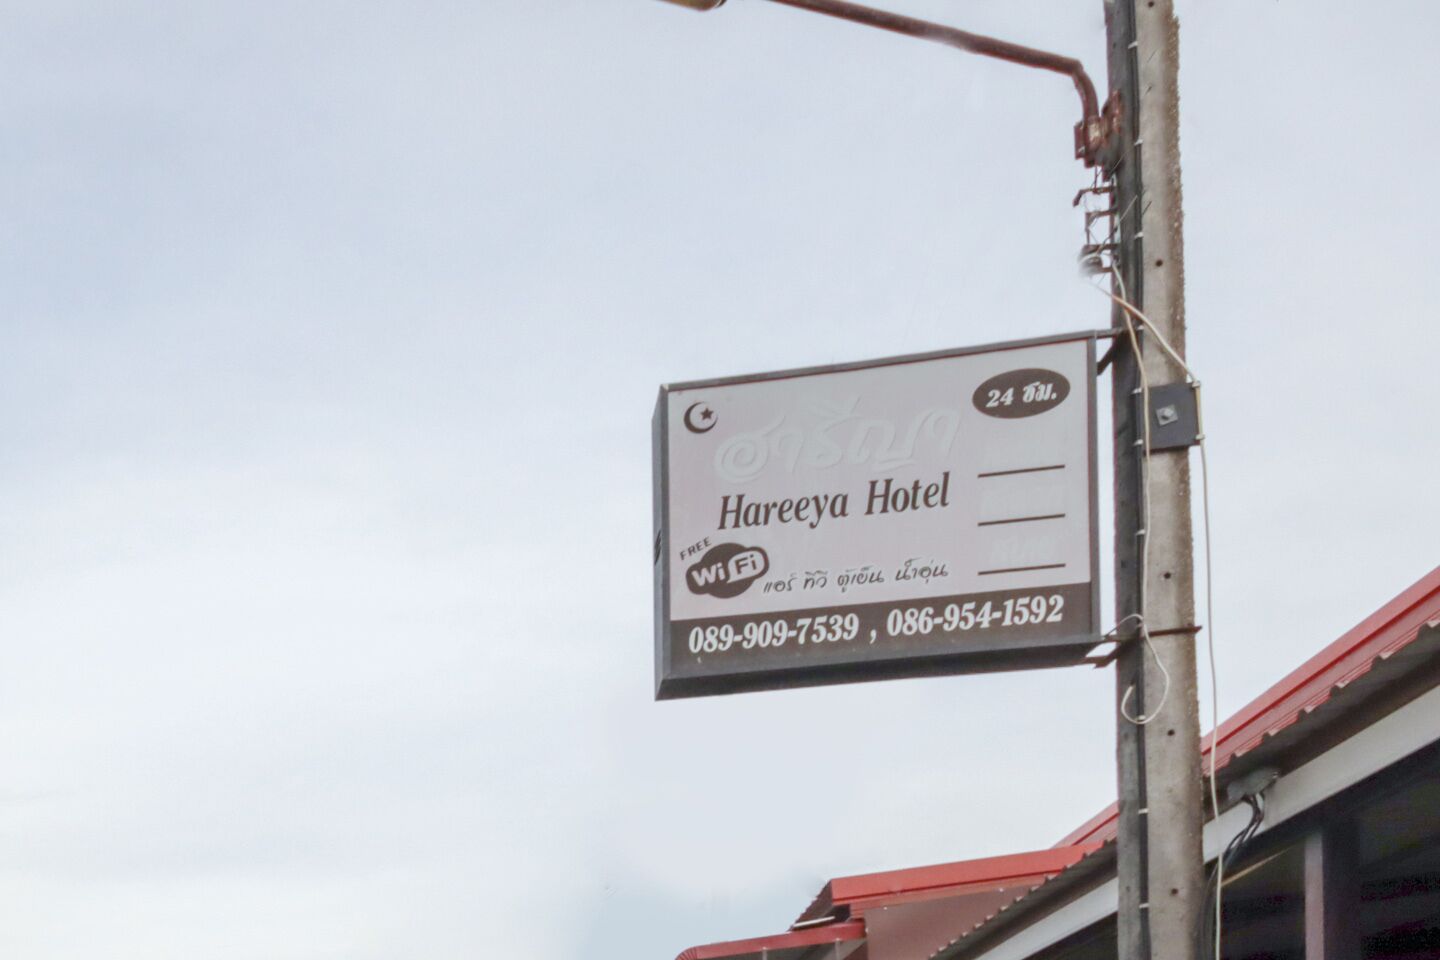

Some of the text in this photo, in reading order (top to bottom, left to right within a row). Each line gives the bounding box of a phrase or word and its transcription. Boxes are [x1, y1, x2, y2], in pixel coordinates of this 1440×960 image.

[985, 387, 1014, 408] 24
[717, 493, 849, 530] Hareeya
[863, 471, 951, 516] Hotel
[679, 536, 712, 560] FREE
[763, 556, 949, 593] แอร์ ทีวี ตู้เย็น น้ำอุ่น
[688, 613, 860, 653] 089-909-7539
[886, 594, 1064, 636] 086-954-1592
